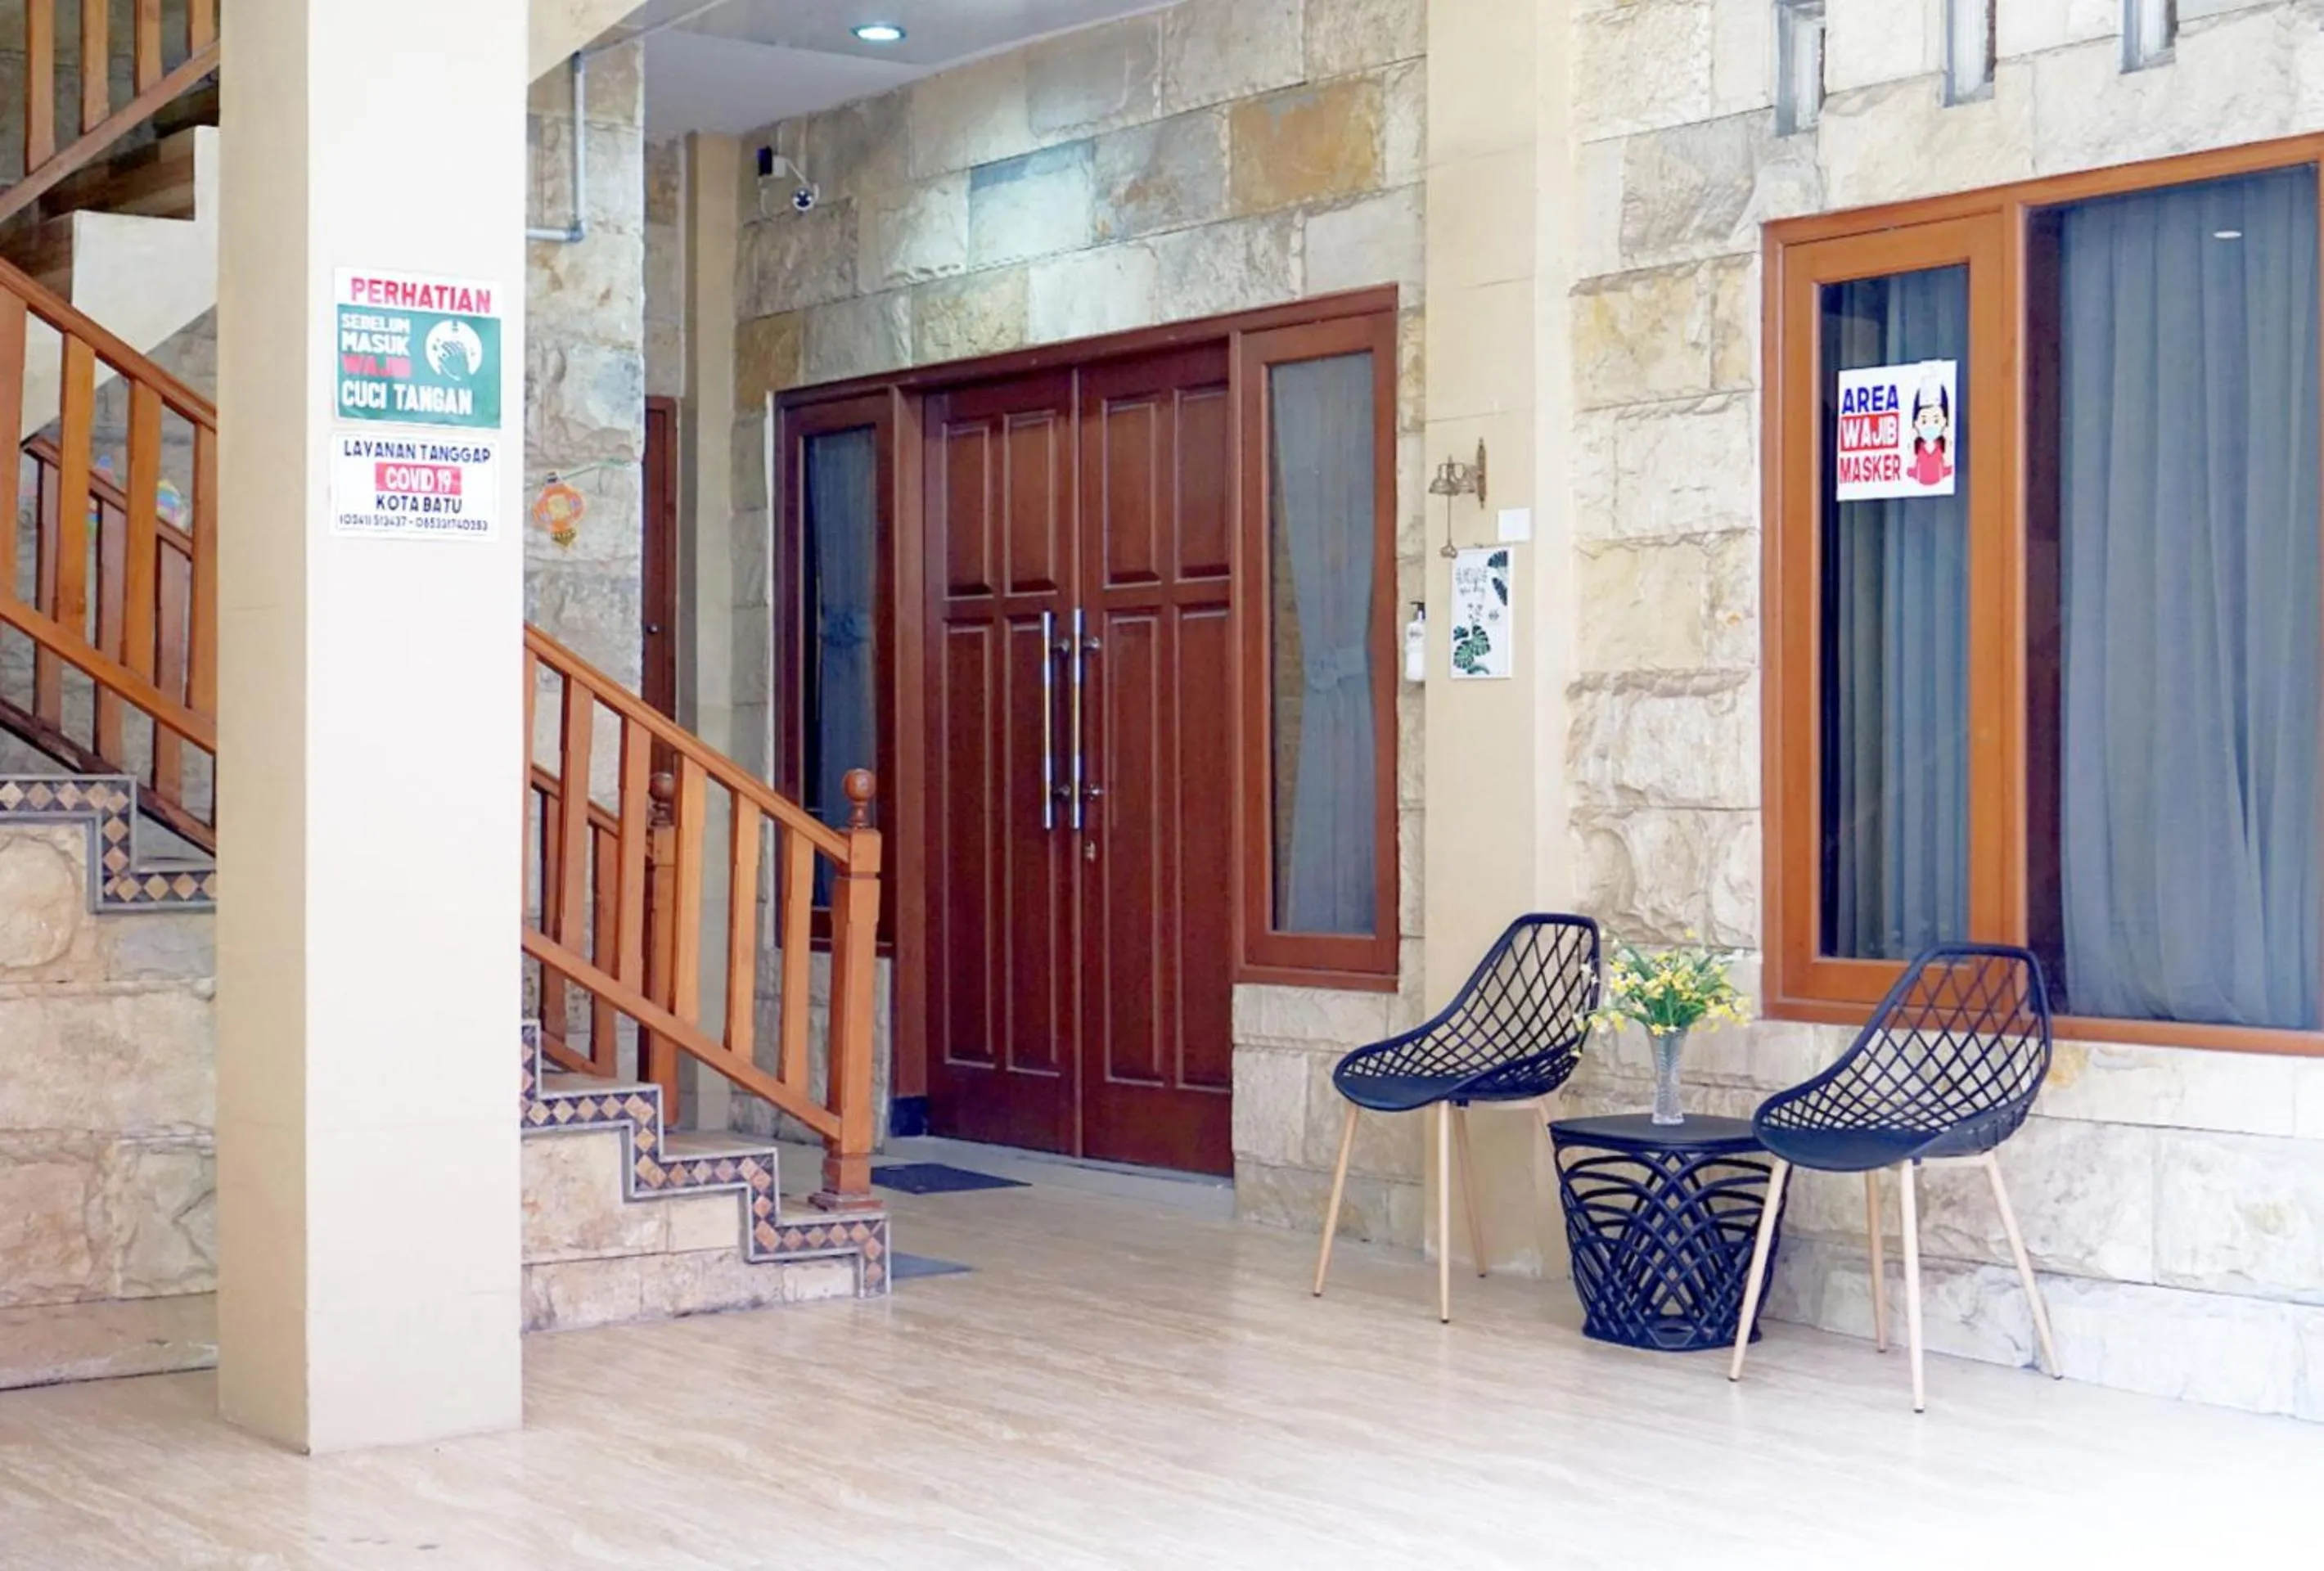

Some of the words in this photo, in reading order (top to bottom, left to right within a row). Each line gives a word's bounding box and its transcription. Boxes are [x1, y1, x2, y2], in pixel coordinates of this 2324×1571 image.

[351, 277, 491, 313] PERHATIAN
[342, 331, 411, 357] MASUK
[342, 380, 386, 409] CUCI
[394, 384, 472, 415] TANGAN
[1841, 385, 1898, 414] AREA
[1841, 416, 1898, 448] WAJIB
[421, 444, 490, 463] TANGGAP
[437, 469, 453, 493] 19
[1840, 455, 1902, 484] MASKER
[376, 494, 419, 511] KOTA
[423, 497, 462, 514] BATU
